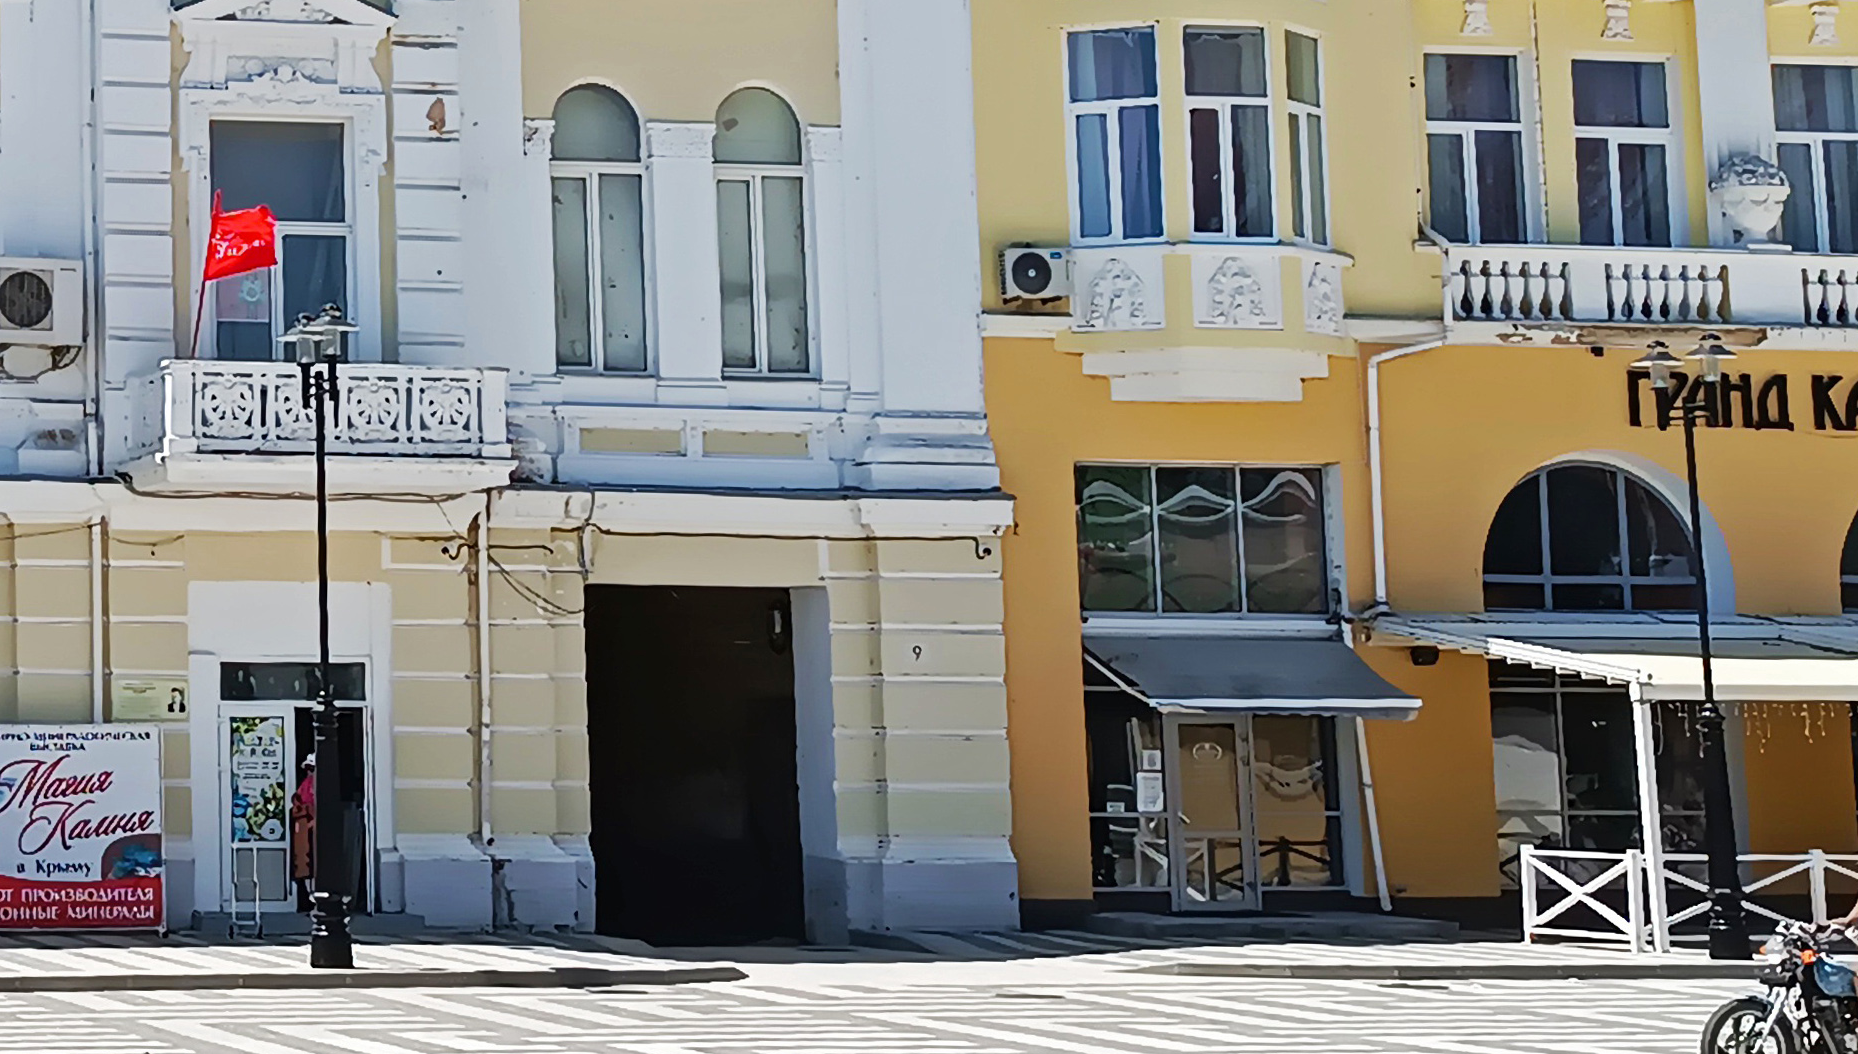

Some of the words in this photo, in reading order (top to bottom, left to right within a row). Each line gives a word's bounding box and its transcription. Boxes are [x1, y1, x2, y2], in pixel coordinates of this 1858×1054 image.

[912, 645, 922, 662] 9
[18, 799, 155, 855] Камня
[36, 859, 91, 877] Крыму
[21, 888, 154, 902] ПРОИЗВОДИТЕЛЯ
[67, 905, 155, 920] МИНЕРАЛЫ
